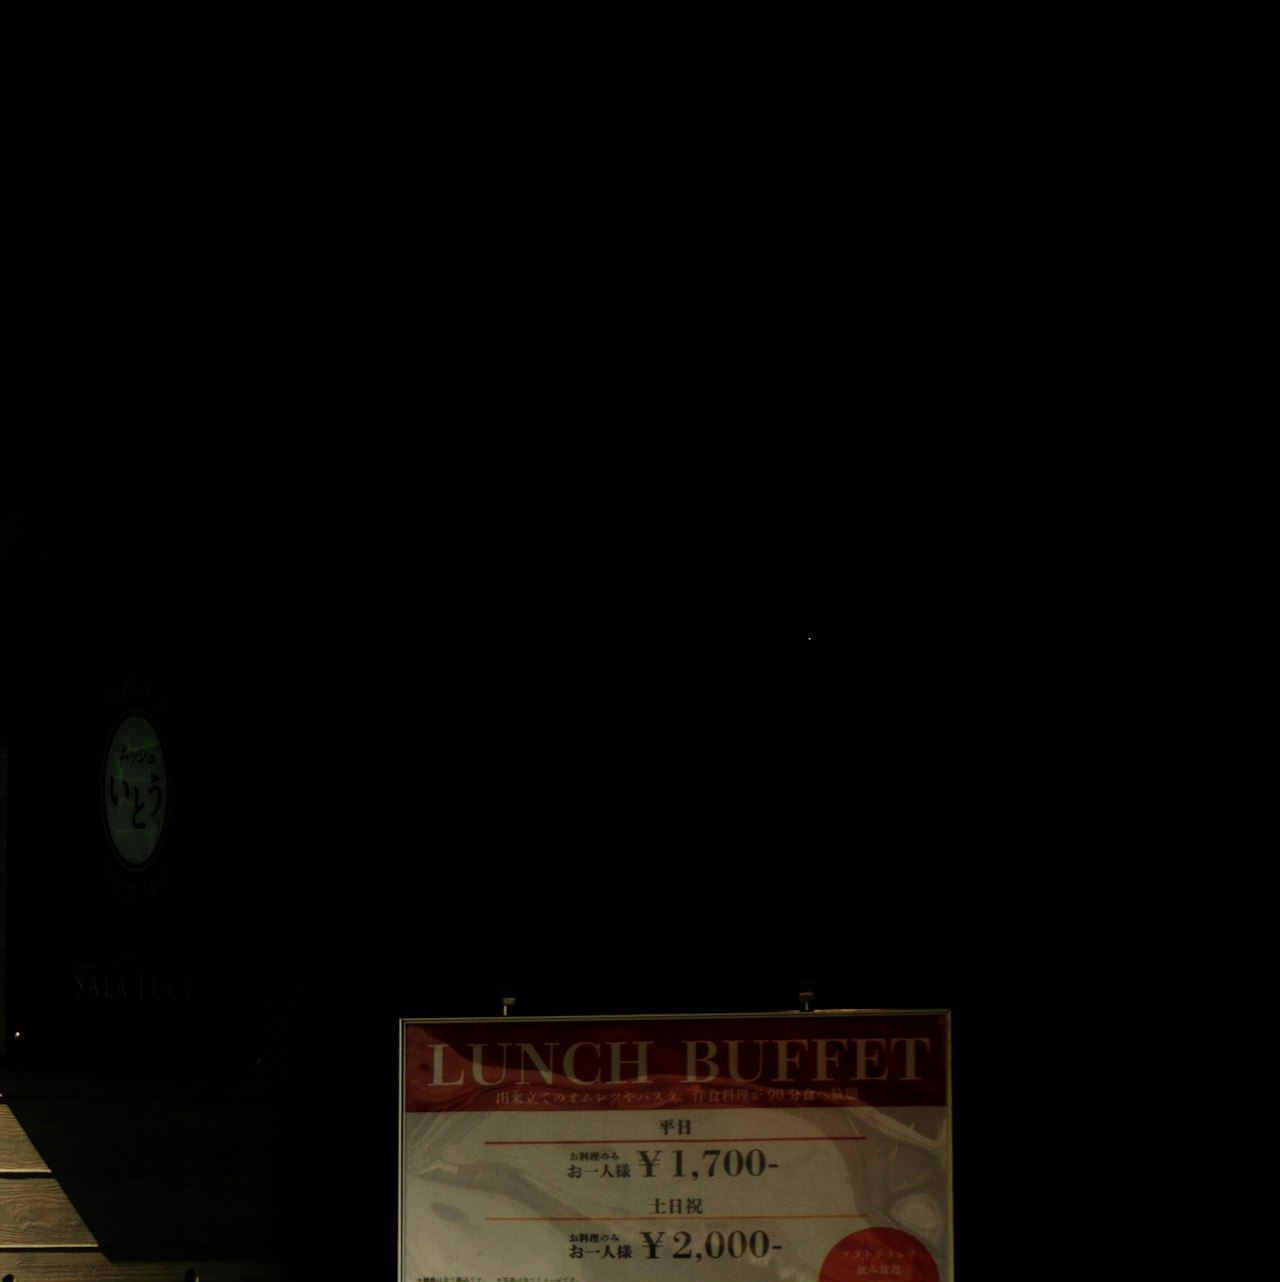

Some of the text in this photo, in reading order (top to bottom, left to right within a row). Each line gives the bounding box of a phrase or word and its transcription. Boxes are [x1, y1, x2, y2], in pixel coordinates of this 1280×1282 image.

[119, 746, 156, 765] ムッシュ
[110, 774, 162, 829] いとう
[72, 969, 128, 1000] SALA
[427, 1036, 930, 1087] LUNCH BUFFET
[659, 1118, 692, 1136] 平日
[569, 1151, 620, 1162] お料理のみ
[567, 1164, 632, 1179] お一人様
[649, 1198, 704, 1215] 土日祝
[569, 1233, 620, 1244] お料理のみ
[569, 1245, 633, 1260] お一人様
[842, 1248, 918, 1260] ソフトドリンク
